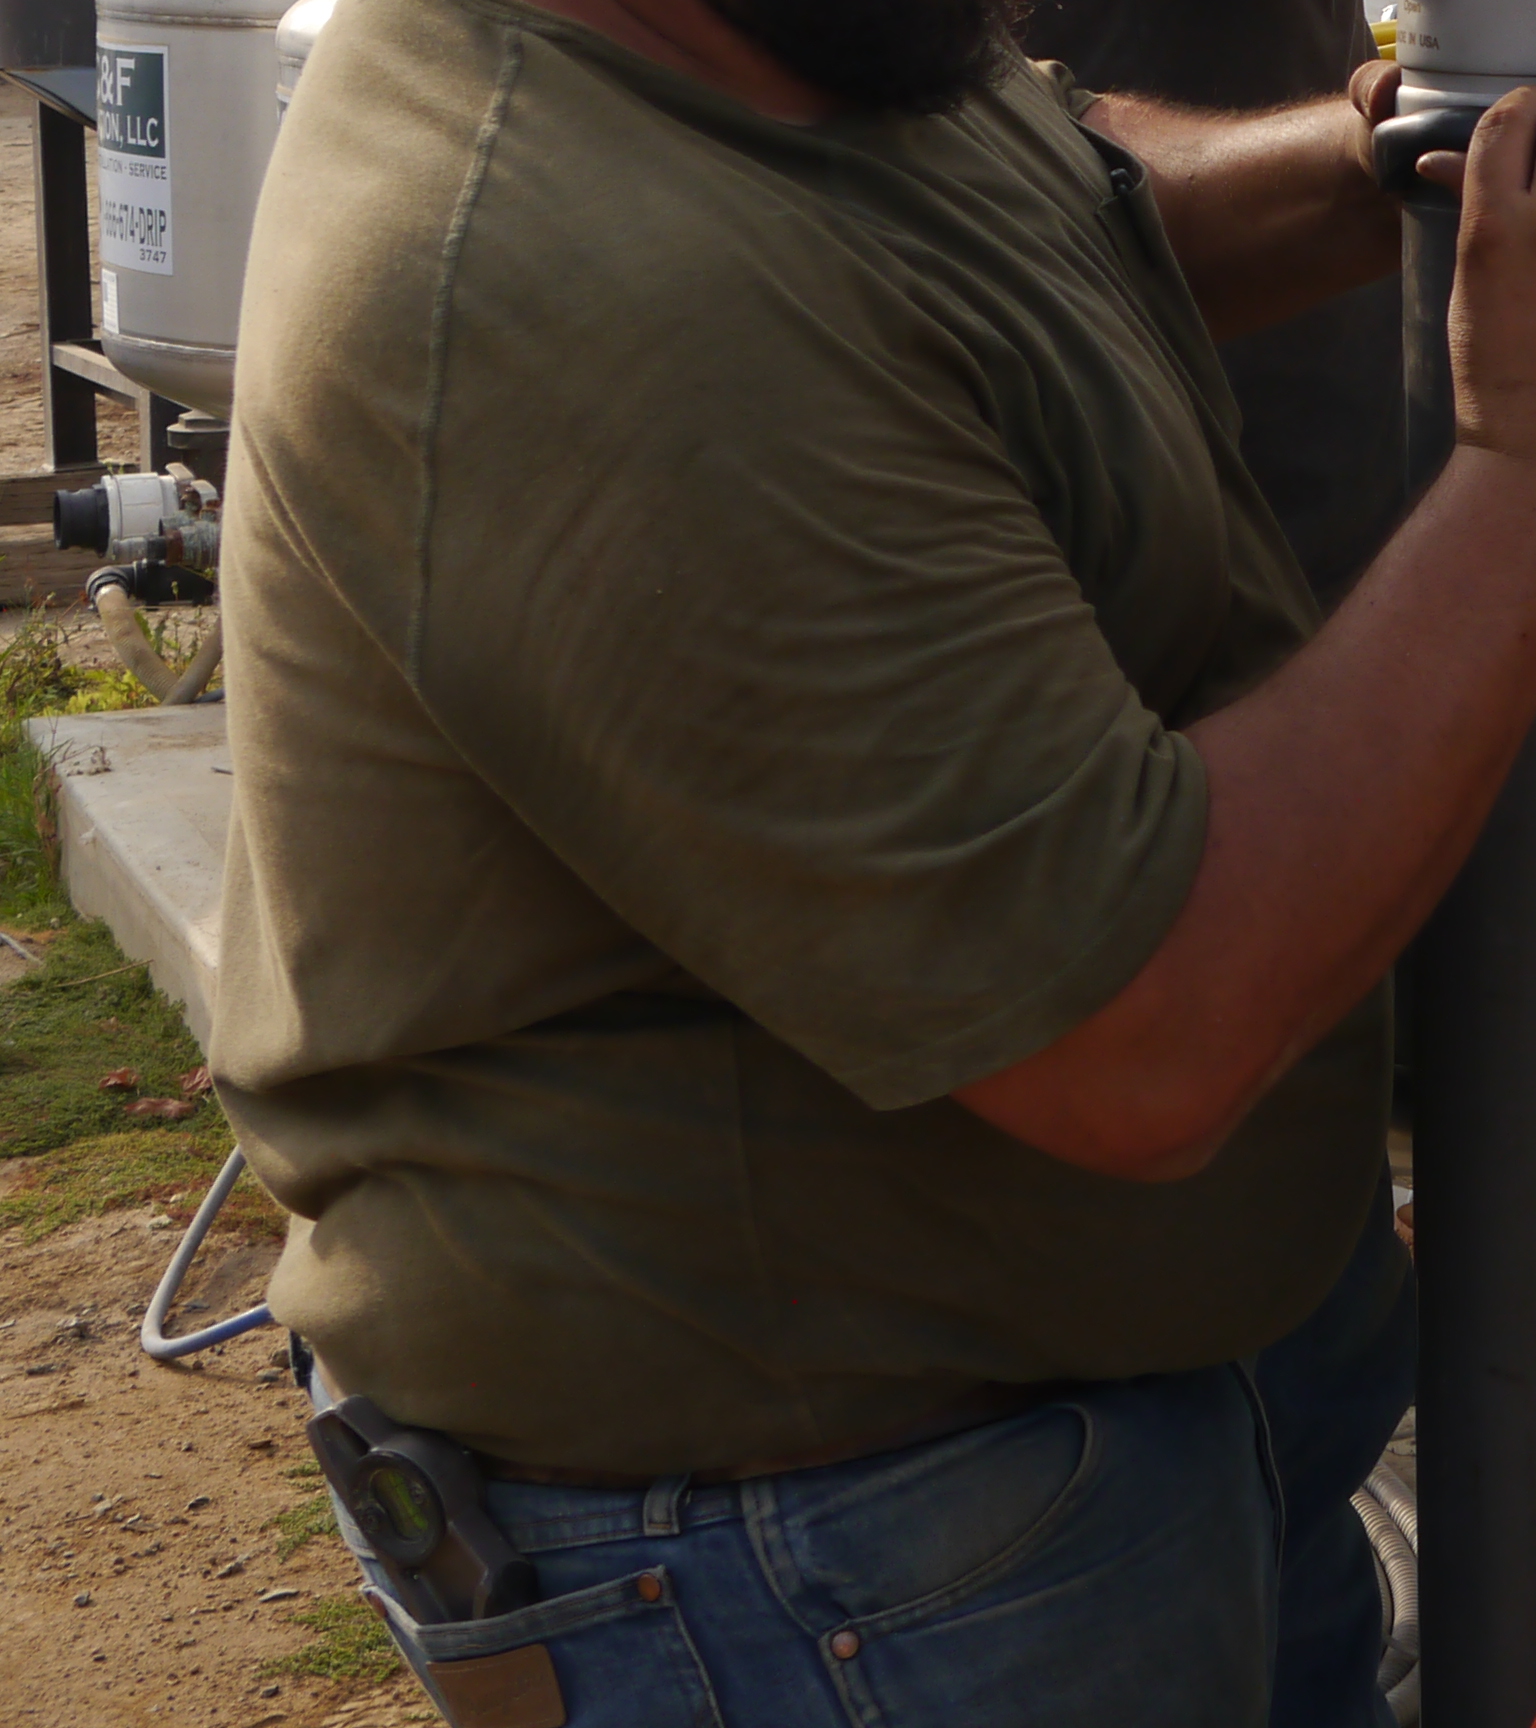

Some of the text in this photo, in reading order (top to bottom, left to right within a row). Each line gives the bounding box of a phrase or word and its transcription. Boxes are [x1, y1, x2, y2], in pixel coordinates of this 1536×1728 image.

[97, 52, 135, 106] &F
[127, 115, 159, 148] LLC
[129, 161, 167, 180] SERVICE
[139, 248, 167, 264] 3747
